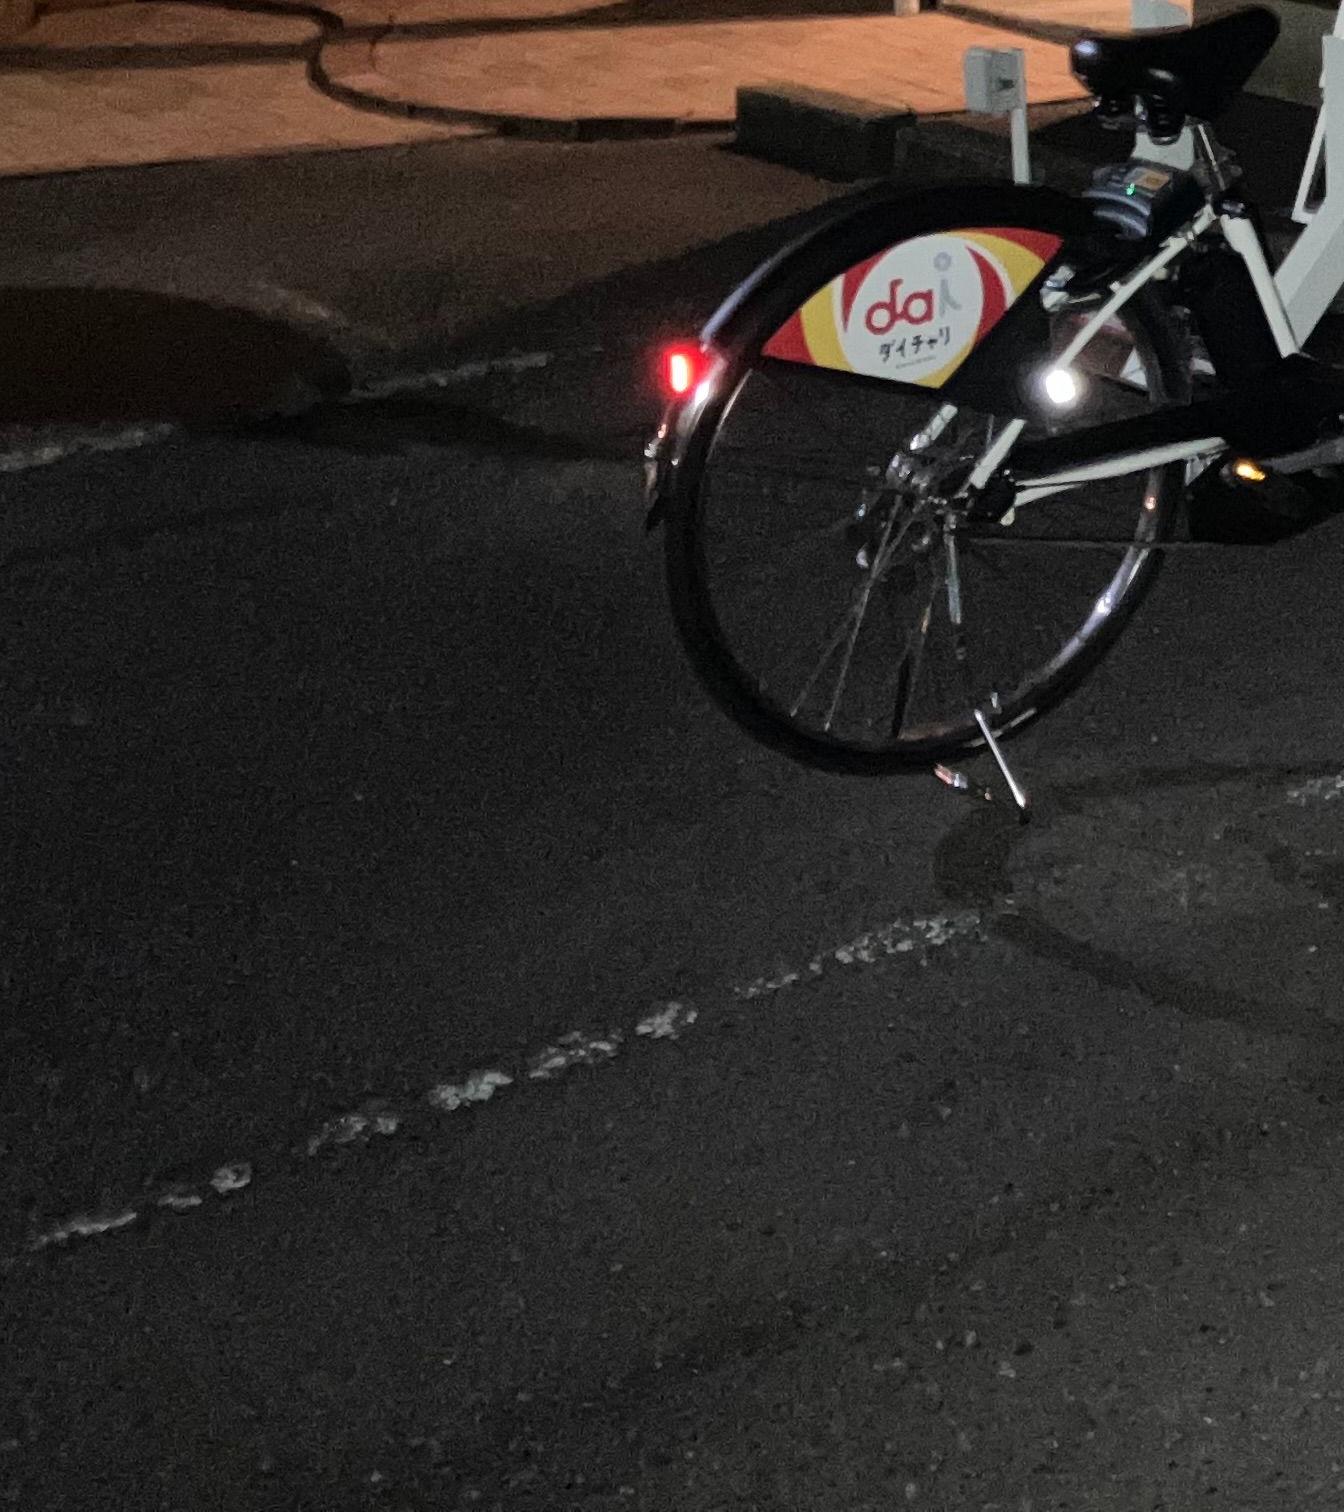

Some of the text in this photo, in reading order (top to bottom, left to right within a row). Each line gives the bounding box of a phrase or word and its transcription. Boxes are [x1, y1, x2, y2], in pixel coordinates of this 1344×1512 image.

[865, 251, 962, 336] dai
[879, 326, 951, 364] ダイチャリ
